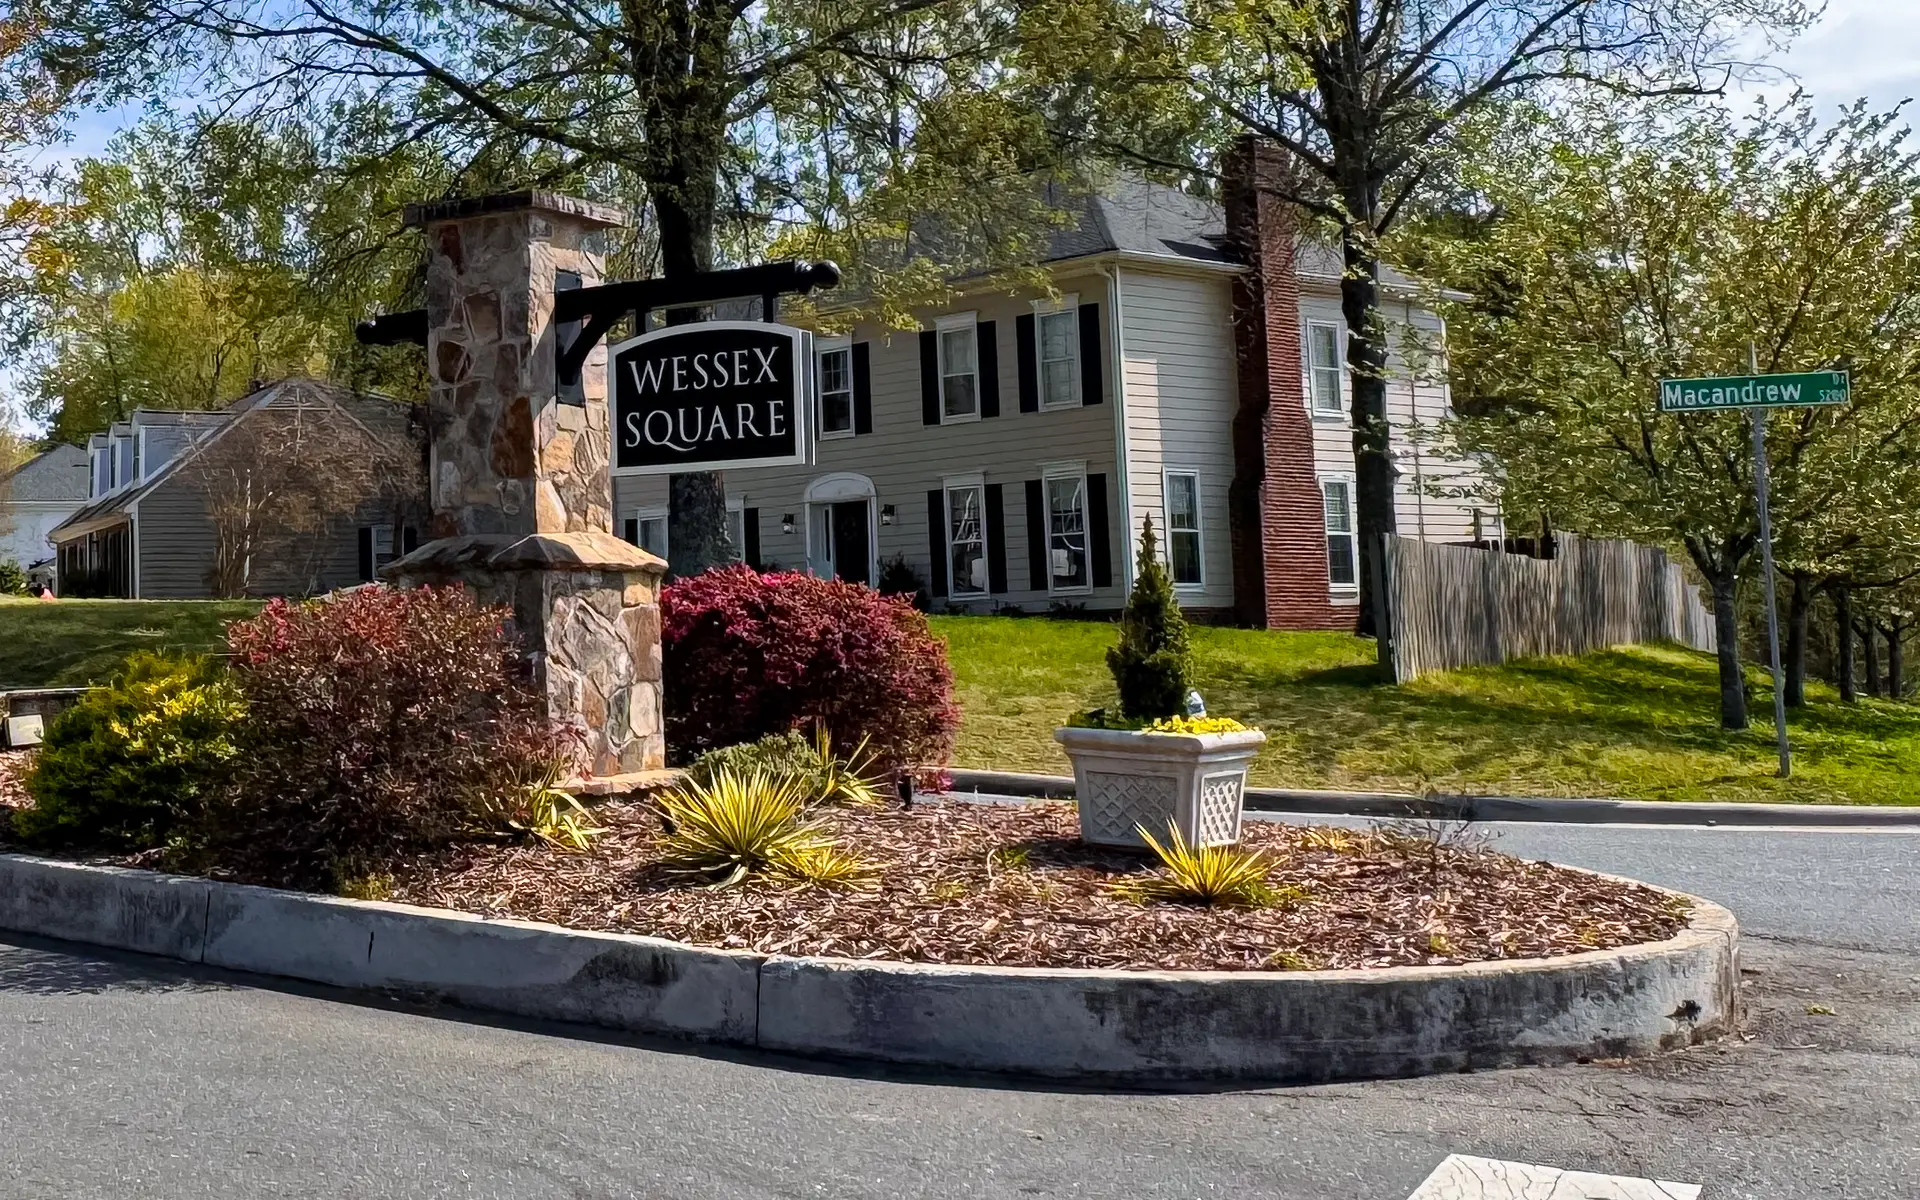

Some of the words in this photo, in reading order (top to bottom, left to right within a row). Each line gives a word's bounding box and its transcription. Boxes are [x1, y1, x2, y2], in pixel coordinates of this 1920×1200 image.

[628, 346, 779, 395] WESSEX
[1665, 381, 1801, 407] Macandrew
[625, 400, 786, 452] SQUARE
